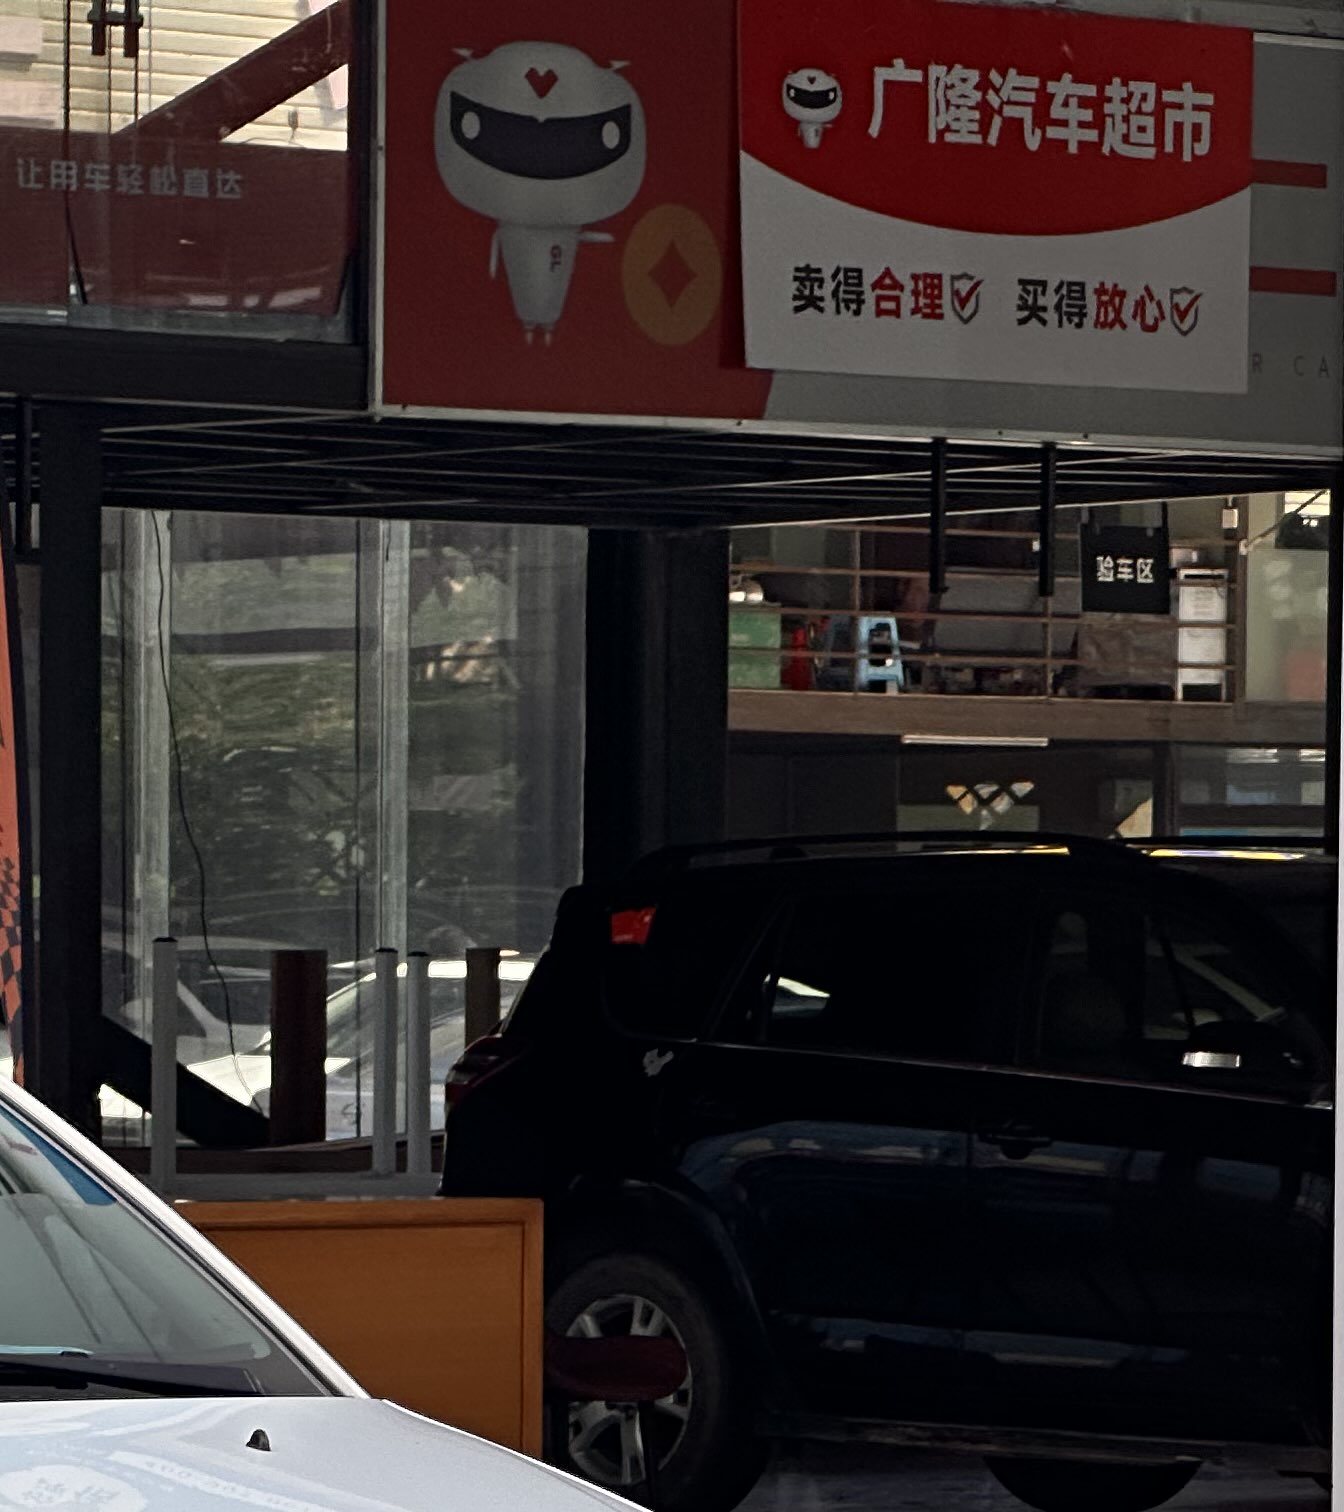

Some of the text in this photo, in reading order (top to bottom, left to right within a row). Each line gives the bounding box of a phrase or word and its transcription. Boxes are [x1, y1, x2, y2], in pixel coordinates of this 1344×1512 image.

[868, 58, 1214, 162] 广隆汽车超市
[792, 264, 1165, 333] 卖得合理 买得放心
[1096, 555, 1154, 583] 验车区
